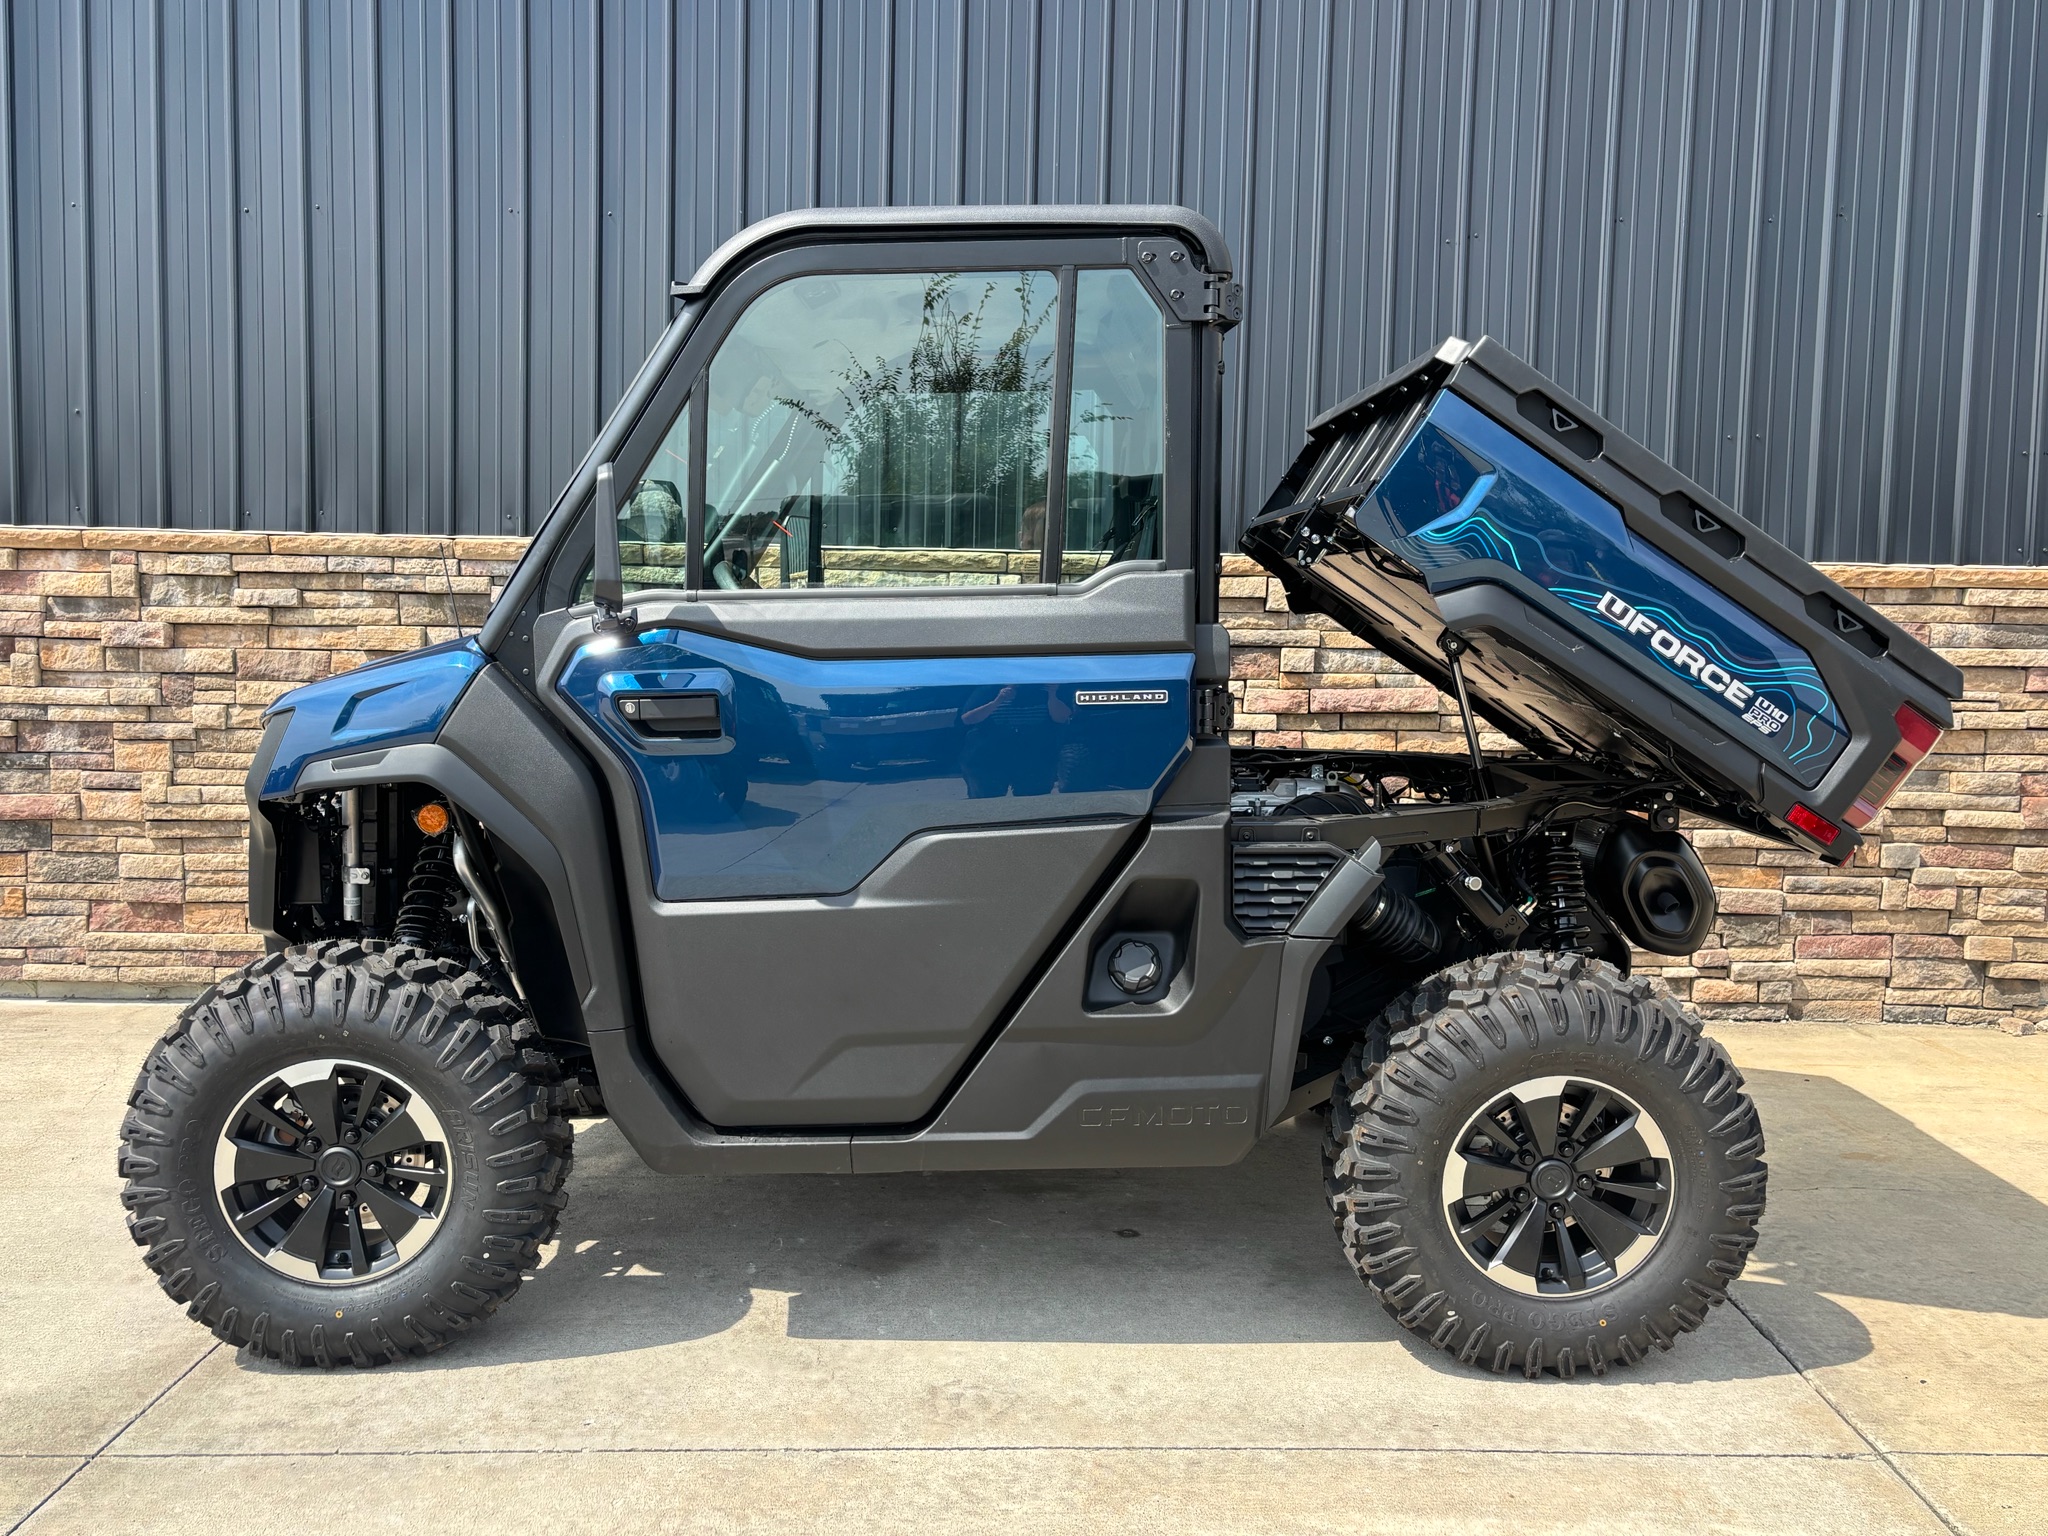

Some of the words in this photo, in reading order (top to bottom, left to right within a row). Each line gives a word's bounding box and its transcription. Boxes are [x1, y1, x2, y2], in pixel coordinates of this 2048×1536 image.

[1597, 591, 1754, 710] UFORCE
[1080, 693, 1164, 701] HIGHLAND
[1754, 696, 1789, 723] U10
[1741, 713, 1772, 735] EPS
[1747, 706, 1781, 732] PRO
[1079, 1104, 1249, 1127] CFMOTO
[441, 1106, 480, 1210] ARISUN
[1527, 1301, 1618, 1332] STEGO
